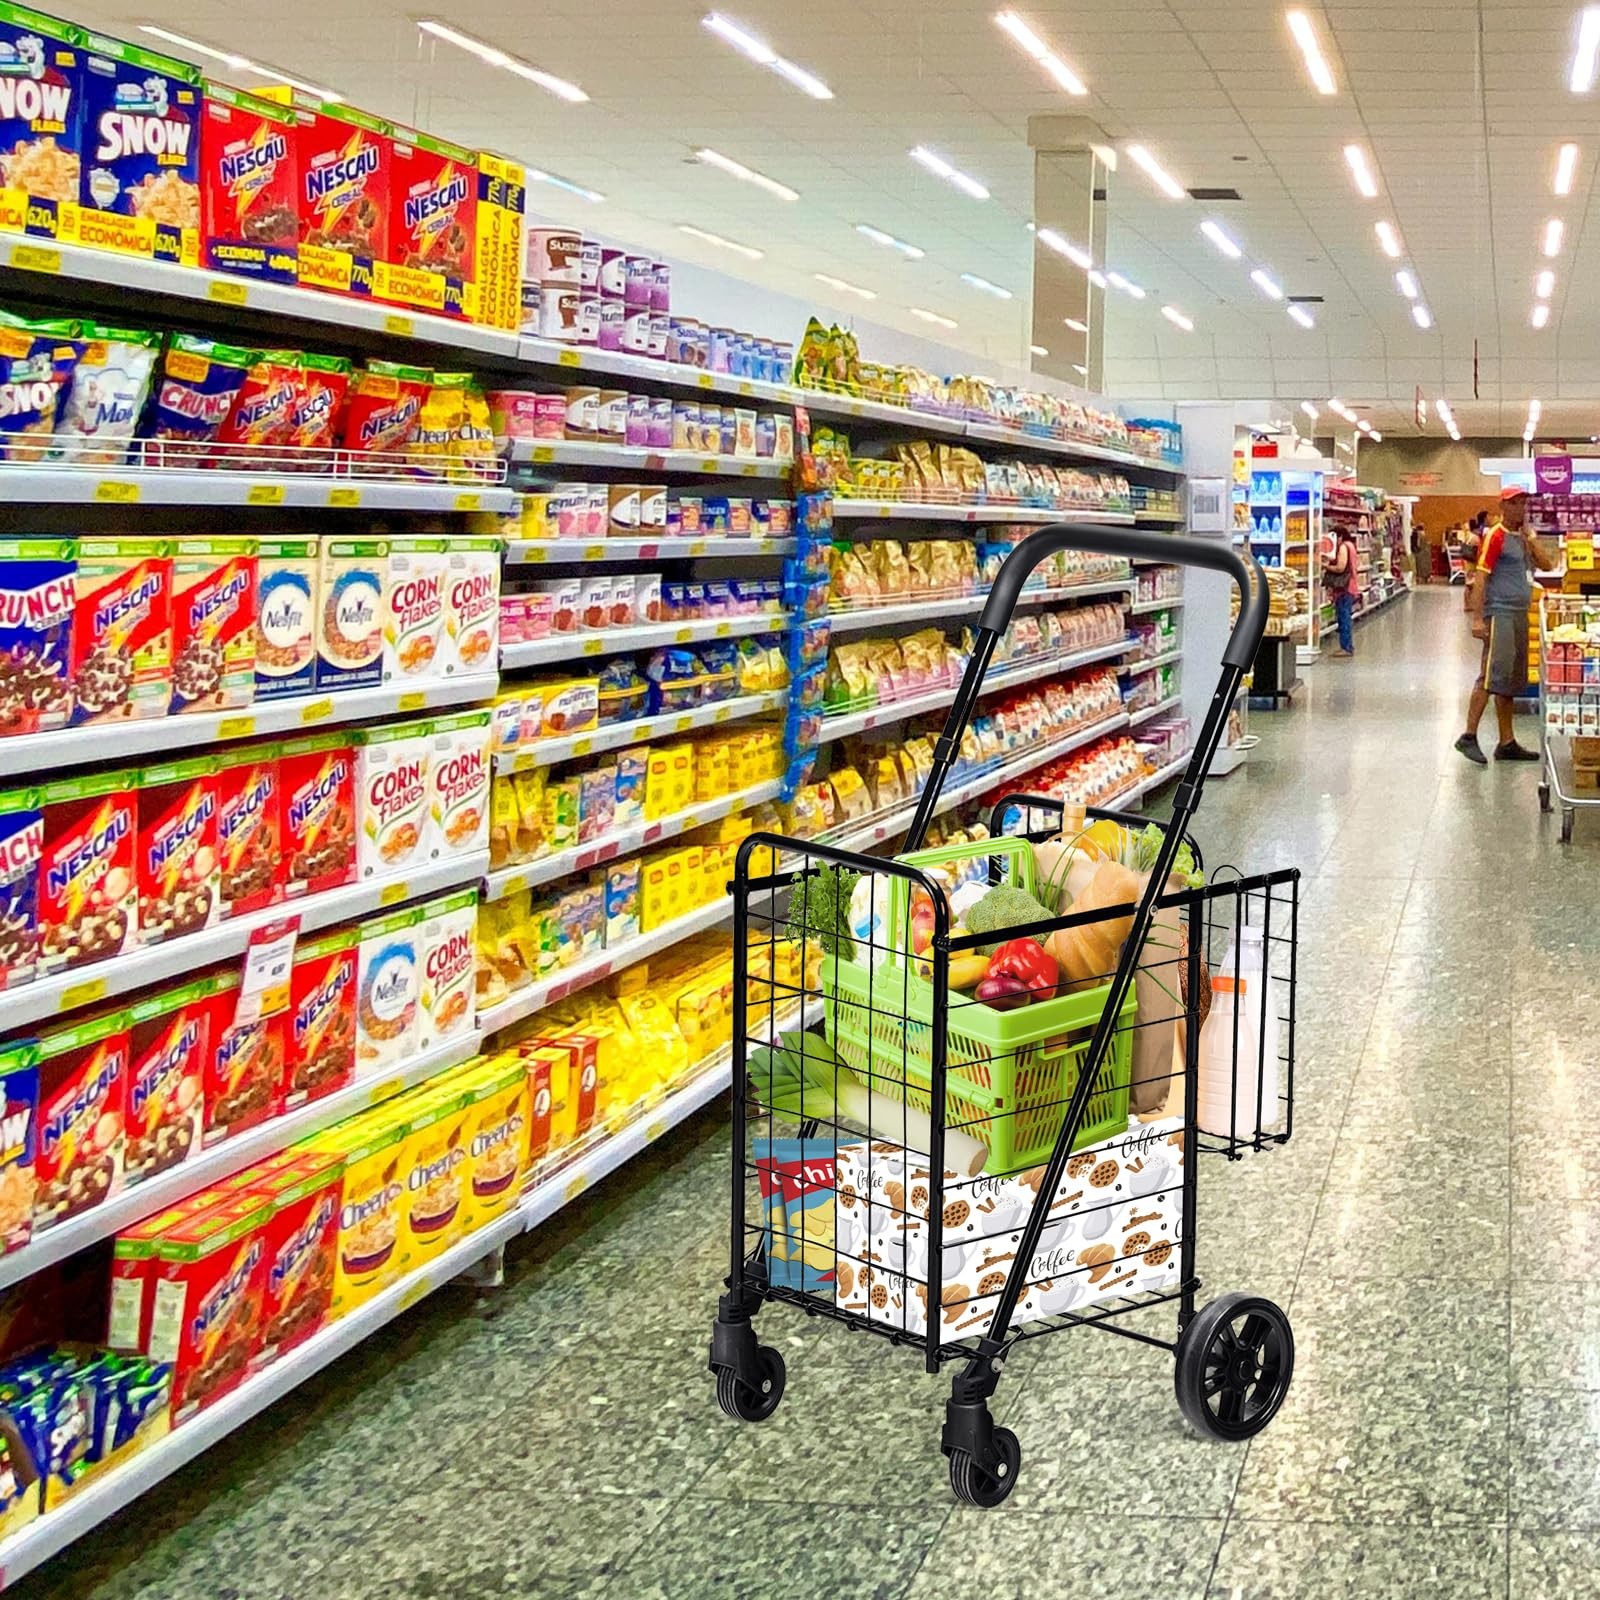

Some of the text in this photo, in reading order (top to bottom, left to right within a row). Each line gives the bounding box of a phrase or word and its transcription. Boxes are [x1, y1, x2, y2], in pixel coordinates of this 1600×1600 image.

[97, 112, 191, 161] SNOW
[220, 135, 286, 186] NESCAU
[307, 149, 379, 201] NESCAU
[405, 176, 468, 228] NESCAU
[235, 383, 294, 430] NESCAU
[361, 396, 420, 440] NESCAU
[95, 574, 161, 634] NESCAU
[190, 571, 248, 628] NESCAU
[391, 576, 438, 613] CORN
[451, 574, 492, 609] CORN
[458, 594, 497, 627] flakes
[265, 607, 303, 630] Nesfit
[340, 603, 374, 626] Nesfit
[399, 597, 442, 632] flakes
[371, 760, 420, 806] CORN
[436, 749, 481, 791] CORN
[444, 769, 486, 809] flakes
[219, 775, 272, 840] NESCAU
[288, 759, 347, 832] NESCAU
[380, 783, 425, 825] flakes
[48, 809, 129, 898] NESCAU
[149, 793, 214, 874] NESCAU
[426, 930, 468, 979] CORN
[434, 953, 473, 996] flakes
[294, 959, 352, 1040] NESCAU
[131, 1018, 199, 1113] NESCAU
[43, 1050, 122, 1155] NESCAU
[471, 1115, 524, 1158] Cheerios
[1121, 1127, 1167, 1159] Coffee
[409, 1148, 466, 1191] Cheerios
[793, 1163, 835, 1190] chi
[856, 1169, 884, 1192] Coffee
[971, 1174, 1018, 1199] Coffee
[340, 1184, 403, 1231] Cheerios
[270, 1194, 337, 1293] NESCAU
[1031, 1247, 1076, 1278] Coffee
[191, 1237, 264, 1345] NESCAU
[889, 1270, 916, 1292] Coffee
